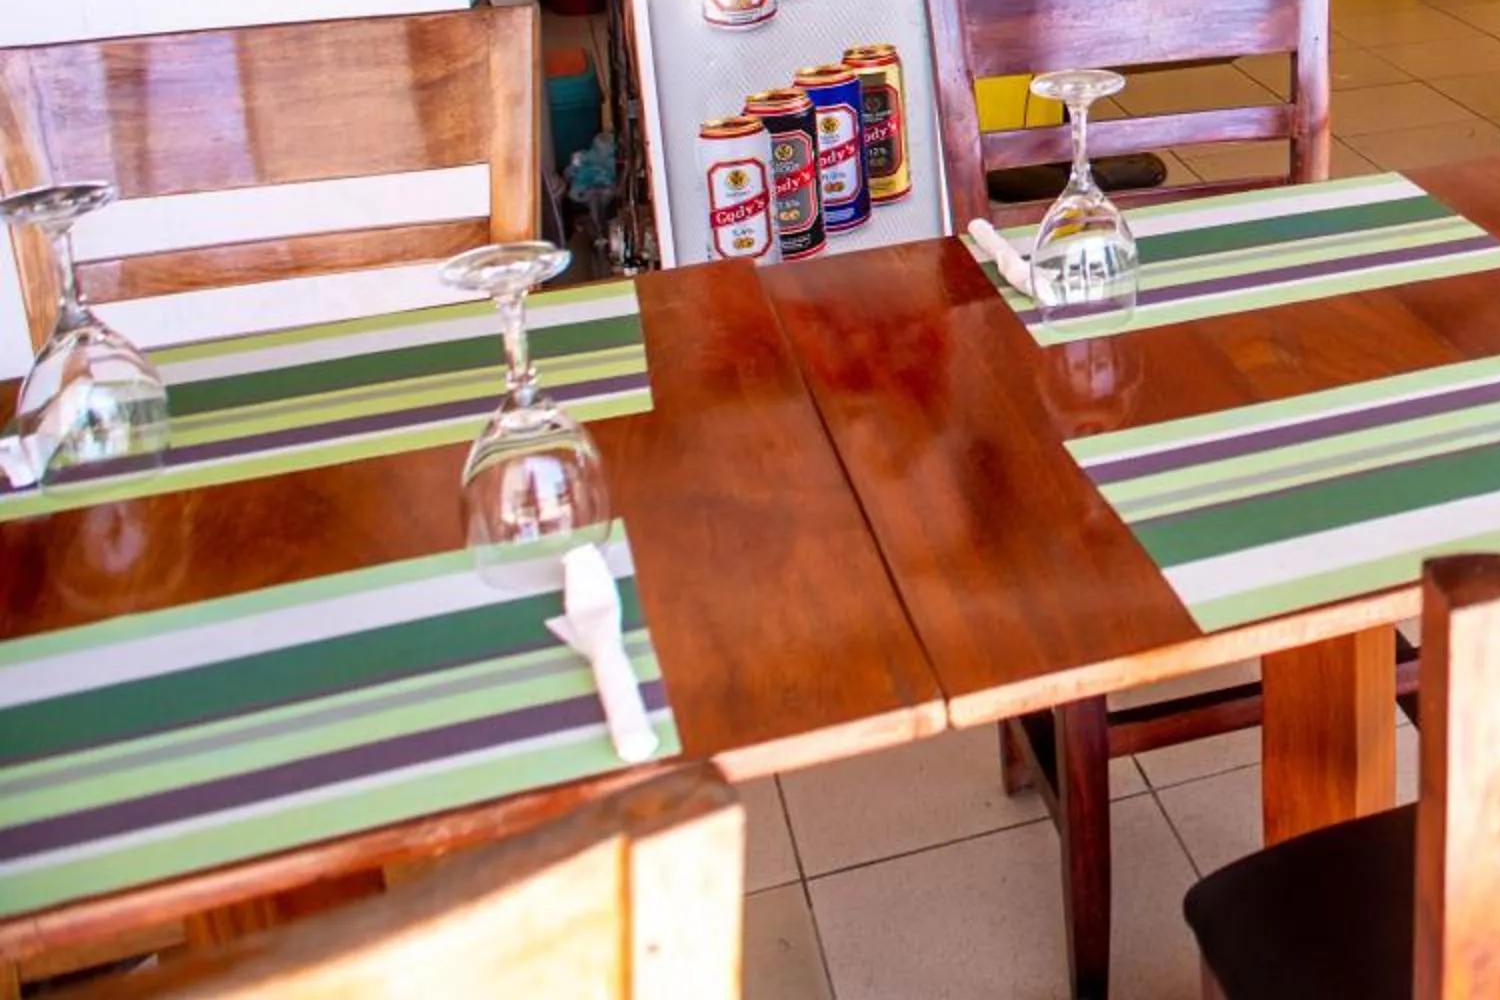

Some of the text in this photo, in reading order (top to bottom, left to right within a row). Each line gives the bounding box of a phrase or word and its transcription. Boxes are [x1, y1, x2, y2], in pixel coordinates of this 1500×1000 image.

[863, 121, 897, 144] ody's
[819, 144, 856, 168] ody's
[776, 171, 812, 194] ody's
[715, 199, 766, 225] Cody's
